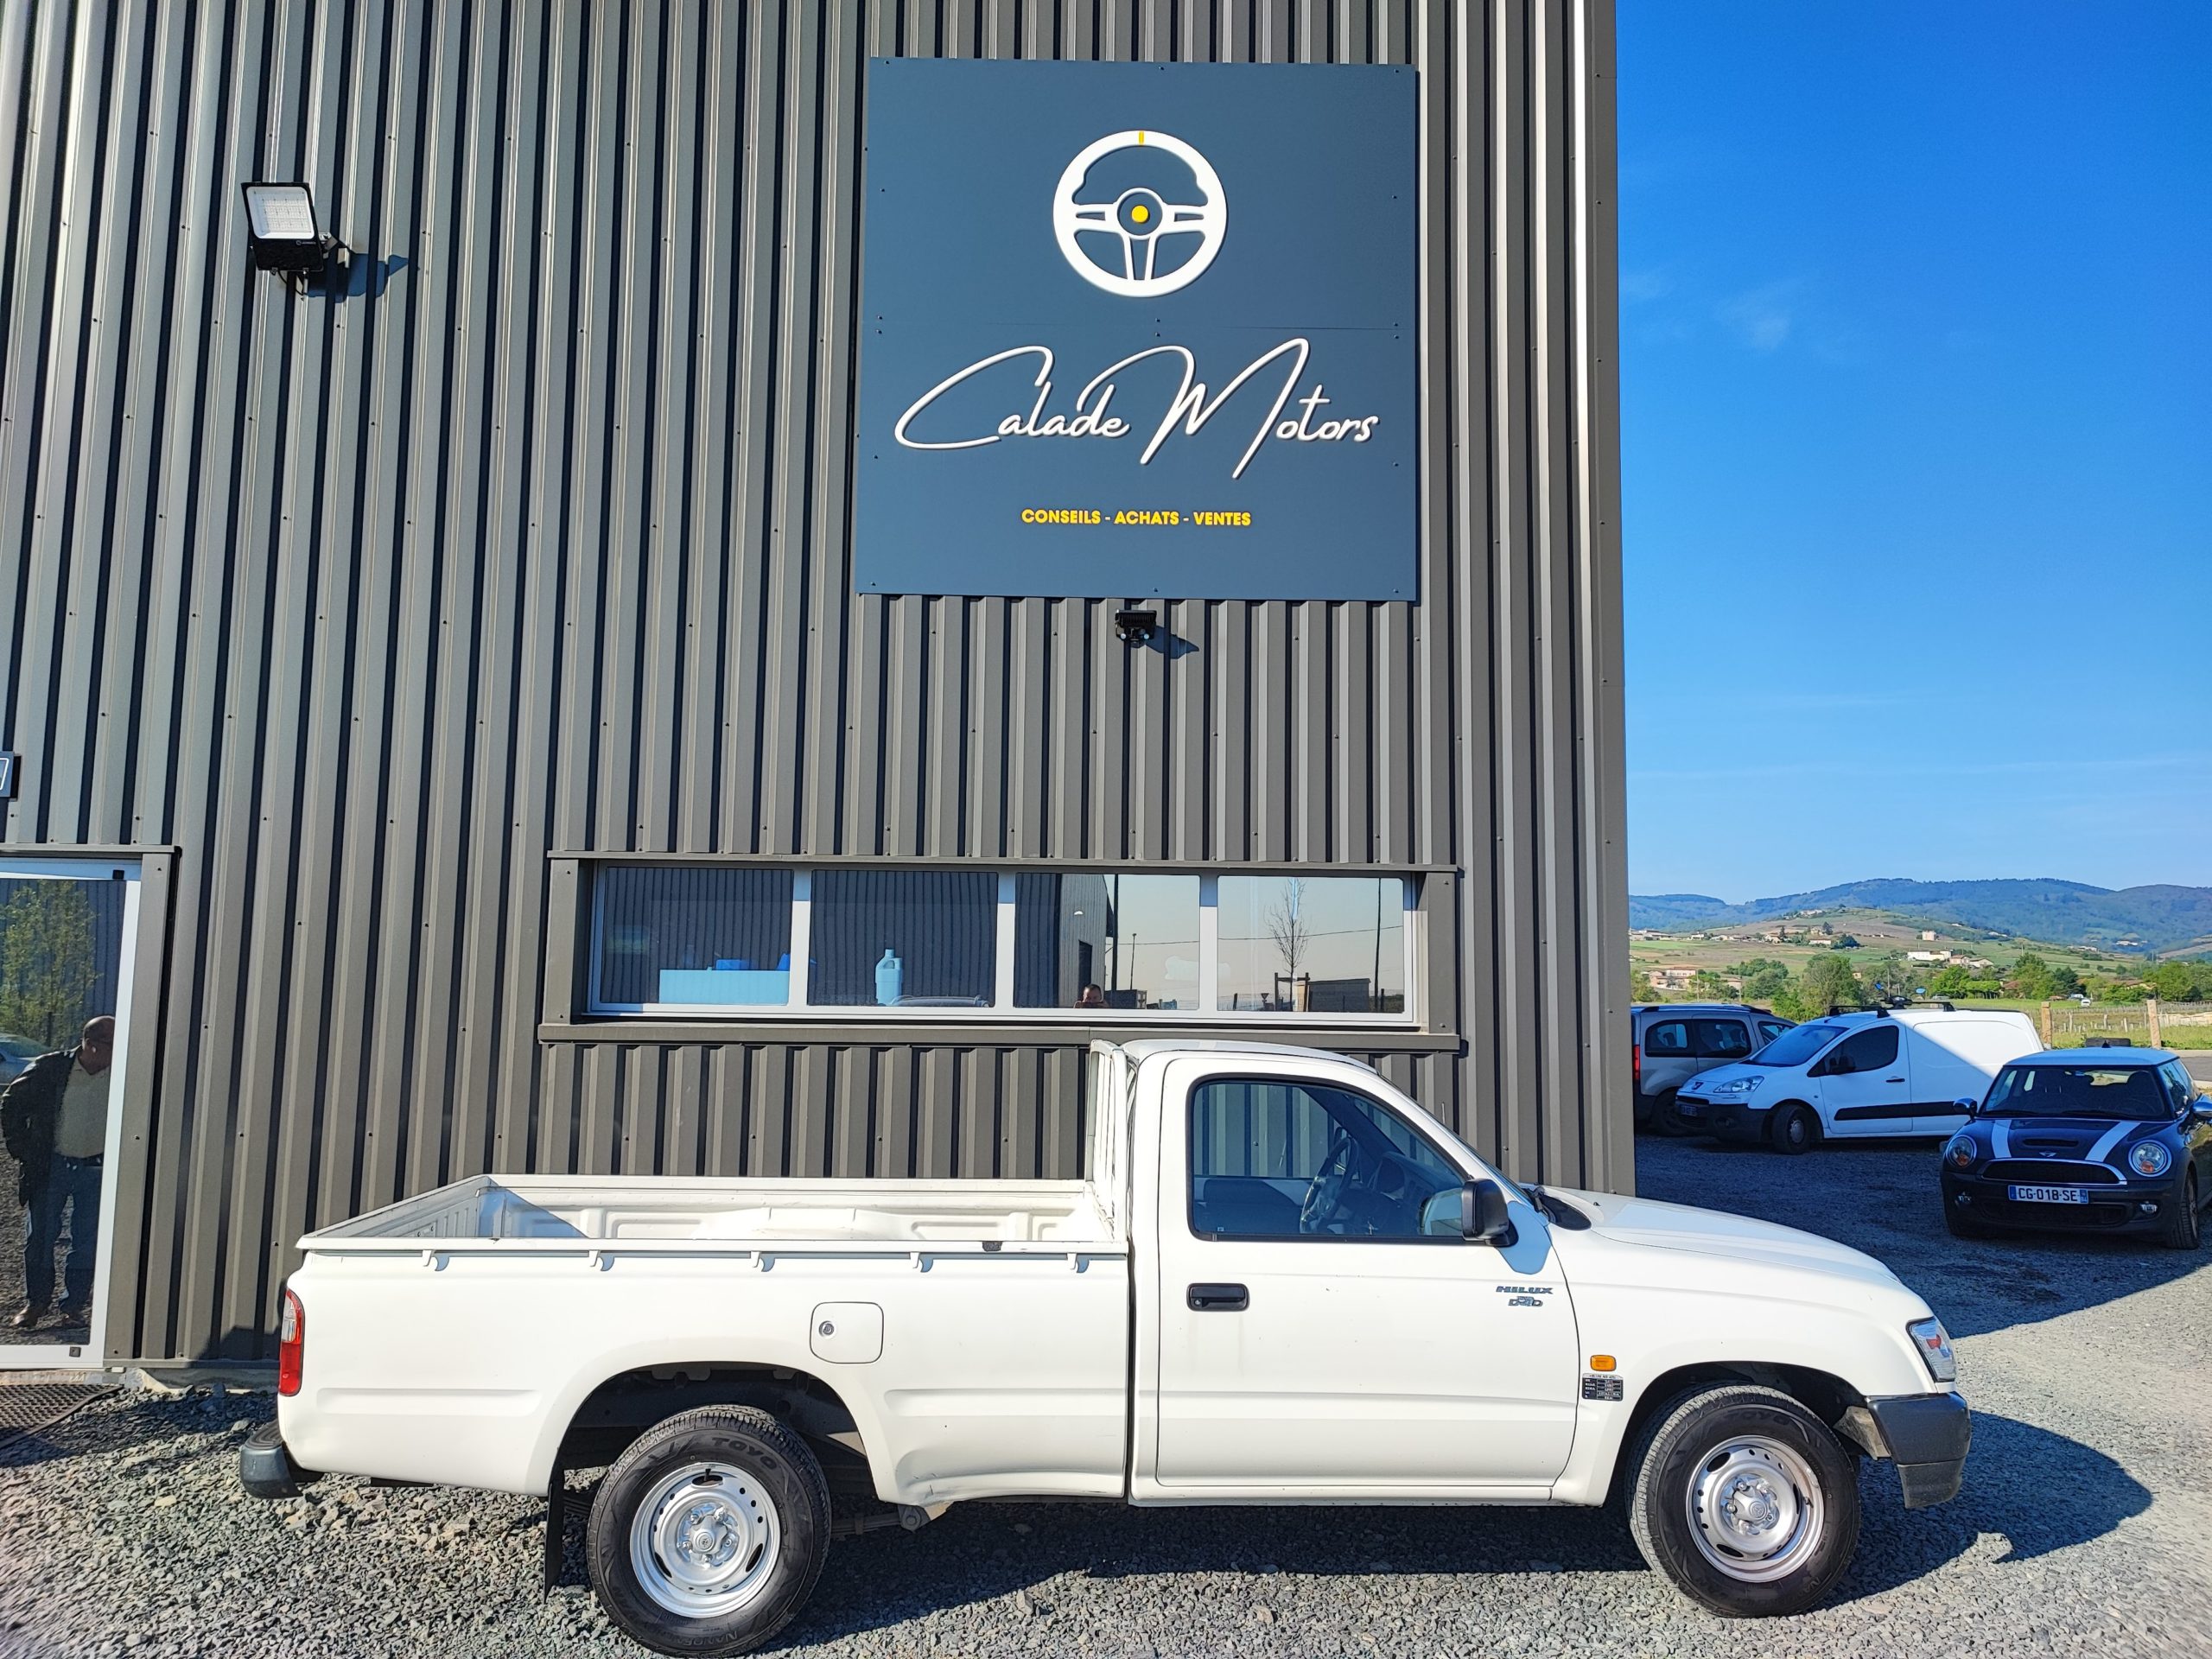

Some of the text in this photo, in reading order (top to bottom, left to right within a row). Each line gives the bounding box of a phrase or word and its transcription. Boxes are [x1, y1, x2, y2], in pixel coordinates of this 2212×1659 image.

[894, 337, 1380, 480] Calade Motors
[1021, 508, 1102, 524] CONSEILS
[1114, 510, 1179, 525] ACHATS
[1193, 512, 1252, 526] VENTES
[2018, 1187, 2078, 1202] CG-018-SE
[1496, 1286, 1554, 1294] HILUX
[711, 1437, 778, 1469] TOYO
